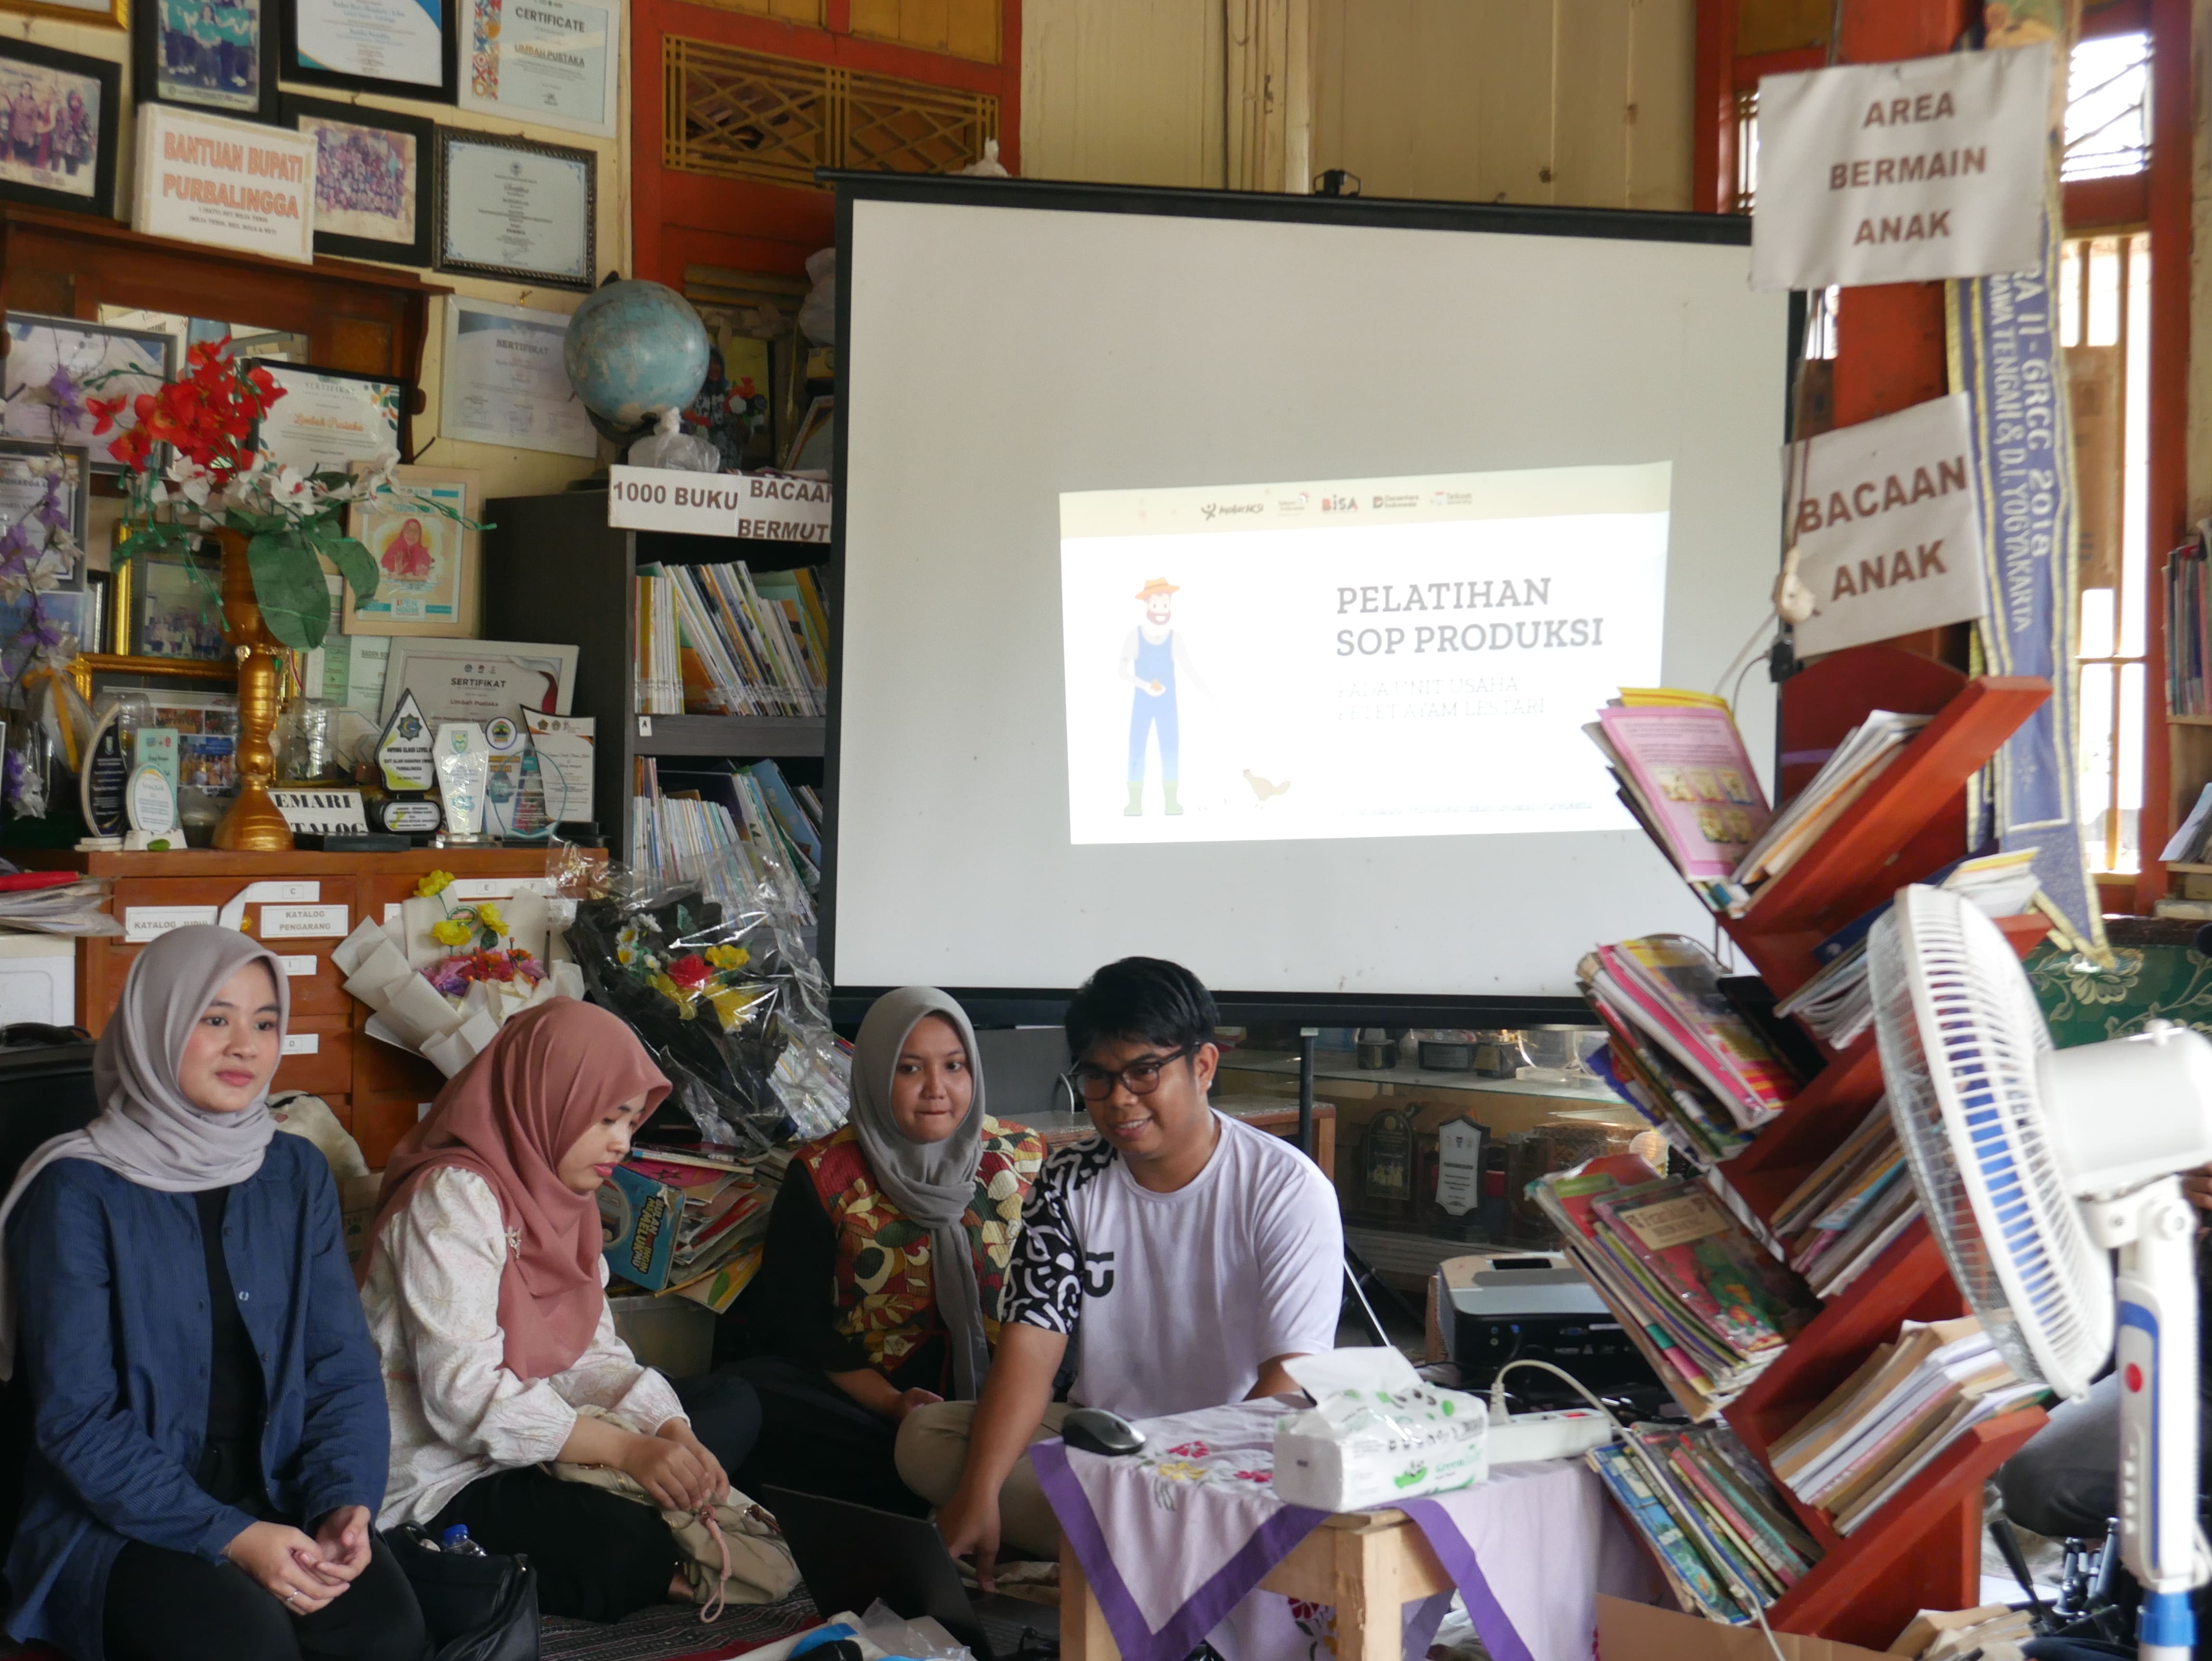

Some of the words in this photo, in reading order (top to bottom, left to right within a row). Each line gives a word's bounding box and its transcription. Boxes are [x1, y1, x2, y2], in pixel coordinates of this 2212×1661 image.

[515, 6, 585, 33] CERTIFICATE
[547, 51, 585, 68] PUSTAKA
[1862, 91, 1956, 129] AREA
[164, 132, 241, 172] BANTUAN
[249, 147, 303, 184] BUPATI
[1828, 146, 1987, 191] BERMAIN
[163, 173, 299, 219] PURBALINGGA
[1853, 209, 1951, 246] ANAK
[496, 339, 550, 355] SERTIFIKAT
[2021, 358, 2054, 451] GRCC
[613, 481, 667, 504] 1000
[674, 487, 739, 511] BUKU
[1797, 455, 1967, 536] BACAAN
[2028, 468, 2054, 557] 2018
[737, 518, 829, 541] BERMUT
[1830, 539, 1947, 602] ANAK
[1336, 577, 1552, 616] PELATIHAN
[1336, 627, 1405, 657] SOP
[1414, 617, 1604, 653] PRODUKSI
[451, 677, 507, 688] SERTIFIKAT
[1395, 678, 1444, 695] UNIT
[1450, 676, 1519, 694] USAHA
[1404, 702, 1458, 718] AYAM
[1465, 698, 1544, 716] LESTARI
[134, 921, 176, 929] KATALOG
[279, 923, 331, 931] PENGARANG
[632, 1196, 656, 1267] MEMELUKMU
